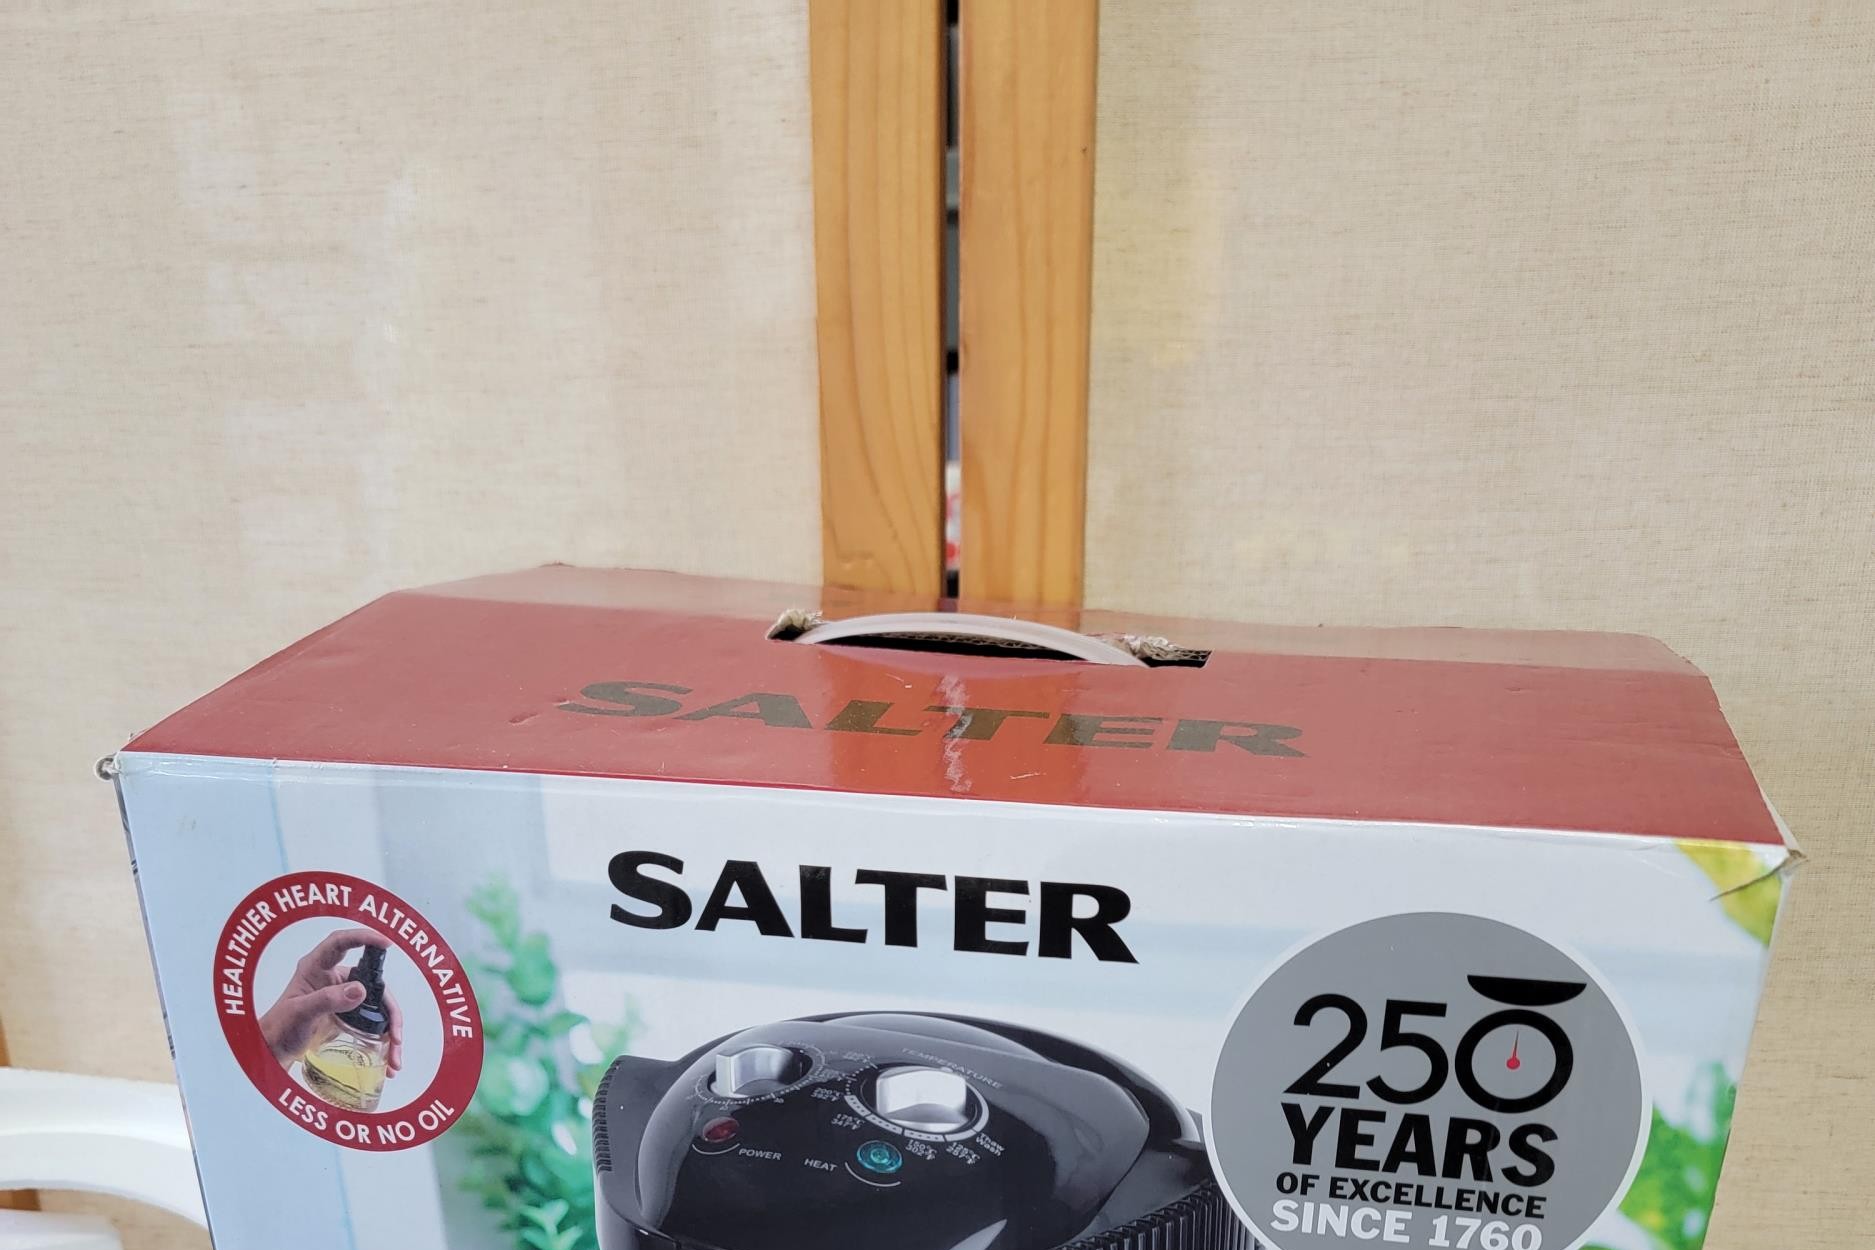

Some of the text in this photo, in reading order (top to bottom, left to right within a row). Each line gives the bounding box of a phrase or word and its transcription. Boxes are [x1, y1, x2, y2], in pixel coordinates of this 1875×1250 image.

[555, 681, 1306, 757] SALTER
[607, 850, 1140, 964] SALTER
[223, 883, 473, 1039] HEALTHIER HEART ALTERNATIVE
[1283, 993, 1574, 1114] 250
[278, 1088, 454, 1145] LESS OR NO OIL
[1280, 1102, 1558, 1188] YEARS
[738, 1148, 782, 1161] POWER
[804, 1158, 838, 1172] HEAT
[1271, 1200, 1411, 1244] SINCE
[1275, 1172, 1547, 1219] OF EXCELLENCE
